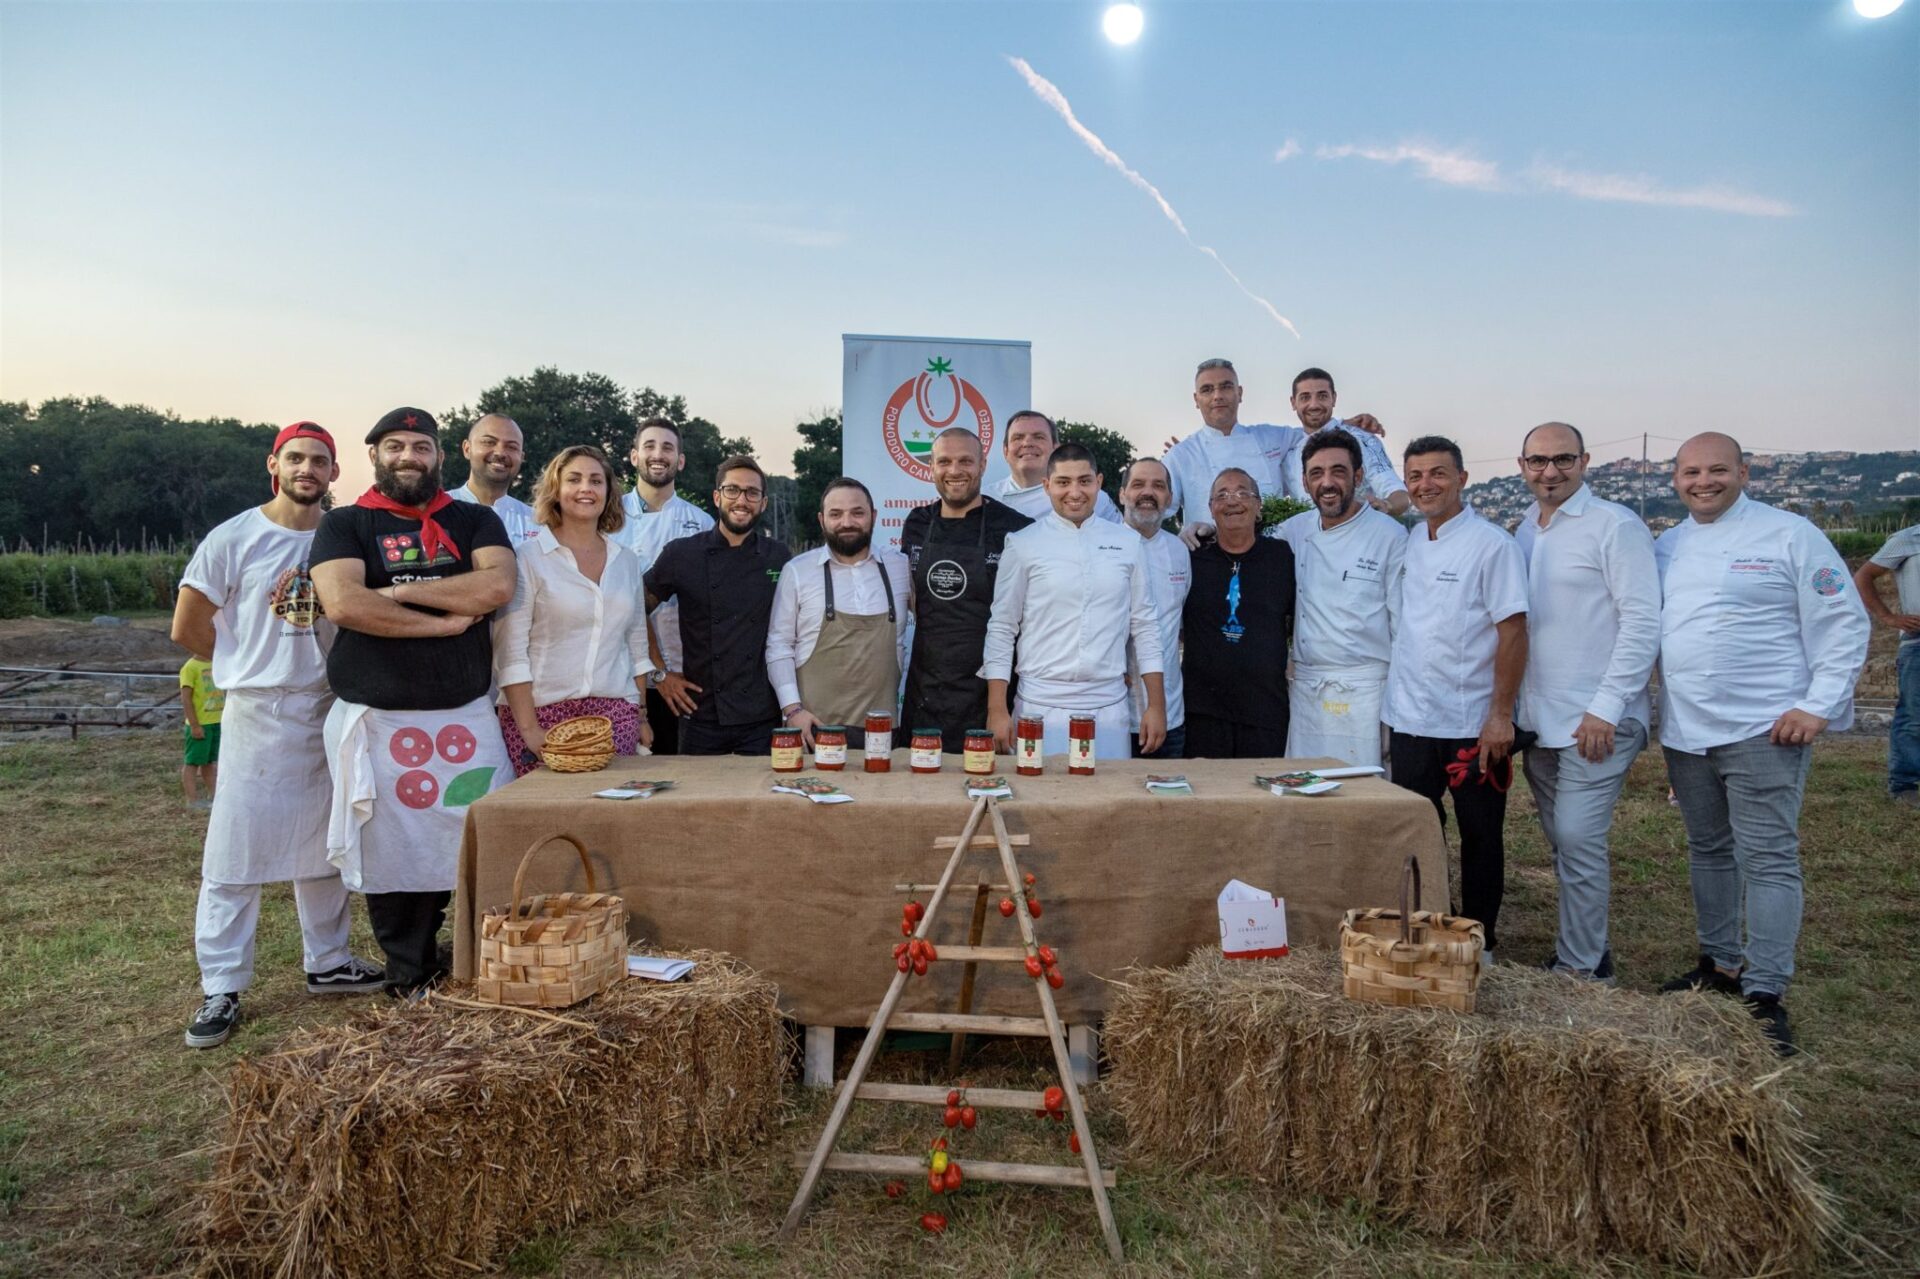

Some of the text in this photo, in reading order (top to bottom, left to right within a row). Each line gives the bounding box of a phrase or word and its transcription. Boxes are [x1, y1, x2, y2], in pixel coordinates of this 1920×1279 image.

[886, 406, 910, 467] POMODORO
[909, 465, 934, 481] CAN
[881, 518, 905, 527] un
